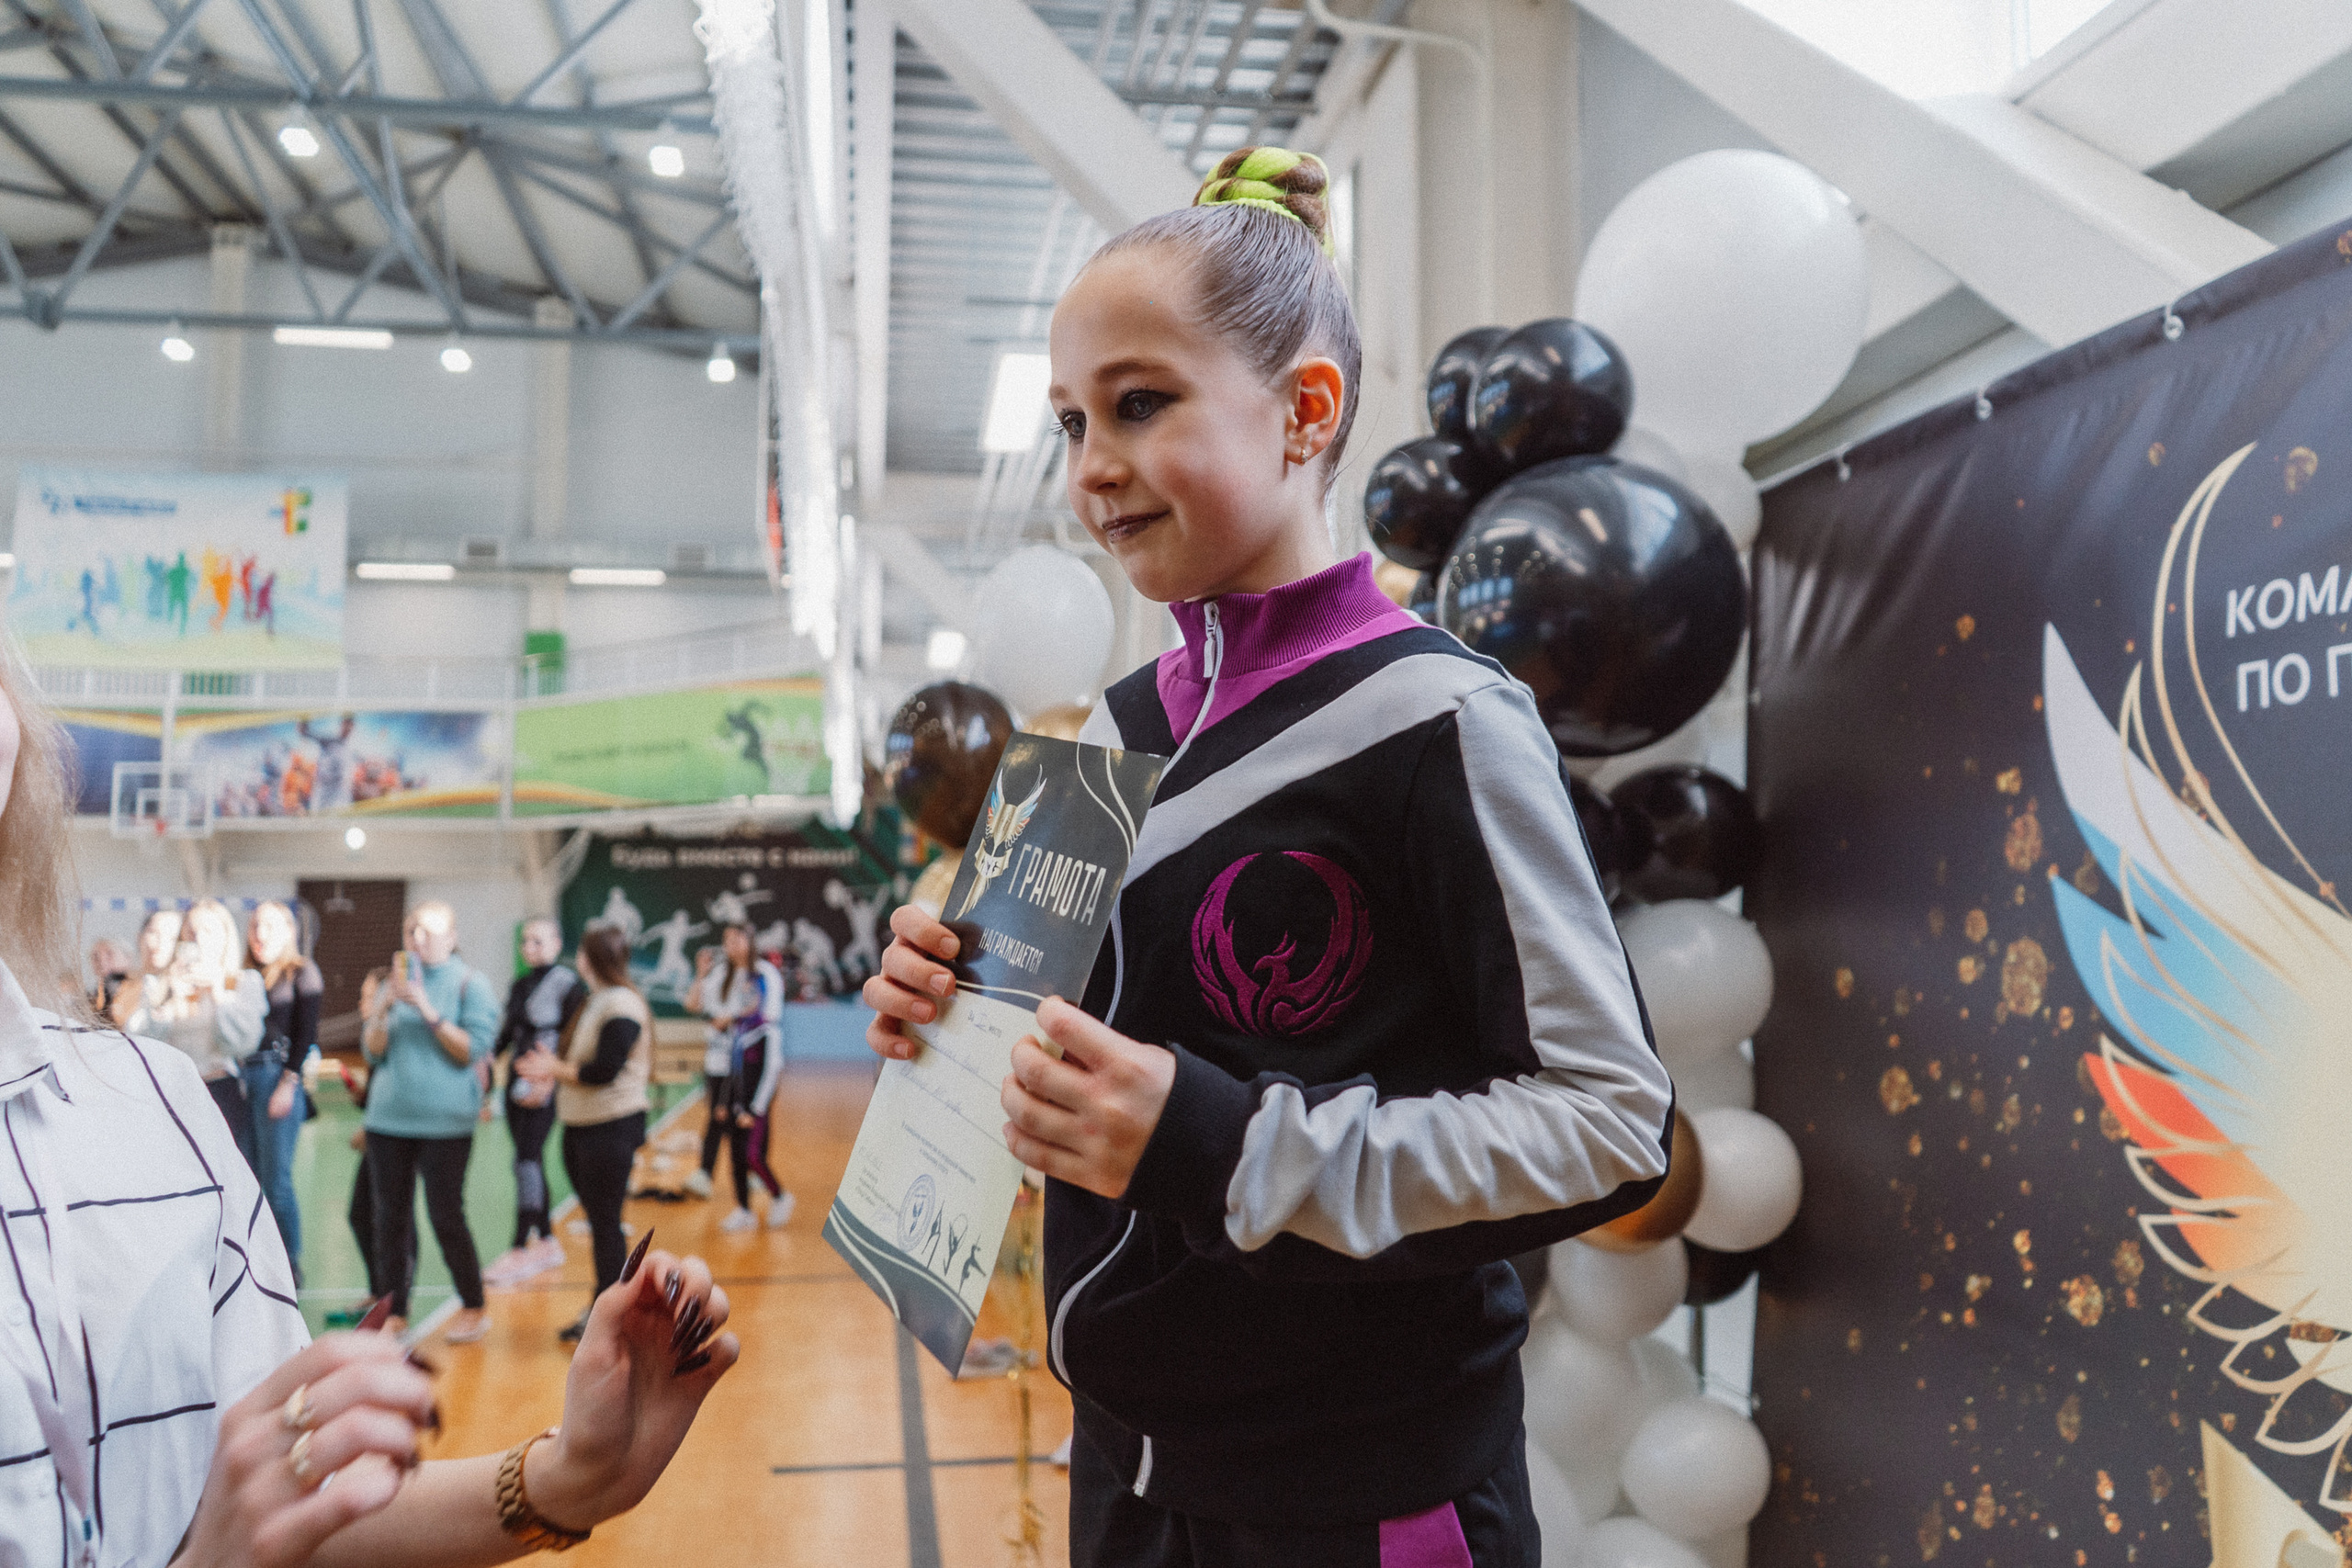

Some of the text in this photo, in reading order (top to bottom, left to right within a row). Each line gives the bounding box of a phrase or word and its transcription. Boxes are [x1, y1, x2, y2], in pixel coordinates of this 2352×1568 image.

[2236, 652, 2312, 713] ПО
[1007, 842, 1108, 926] ГРАМОТА
[978, 927, 1045, 976] НАГРАЖДАЕТСЯ
